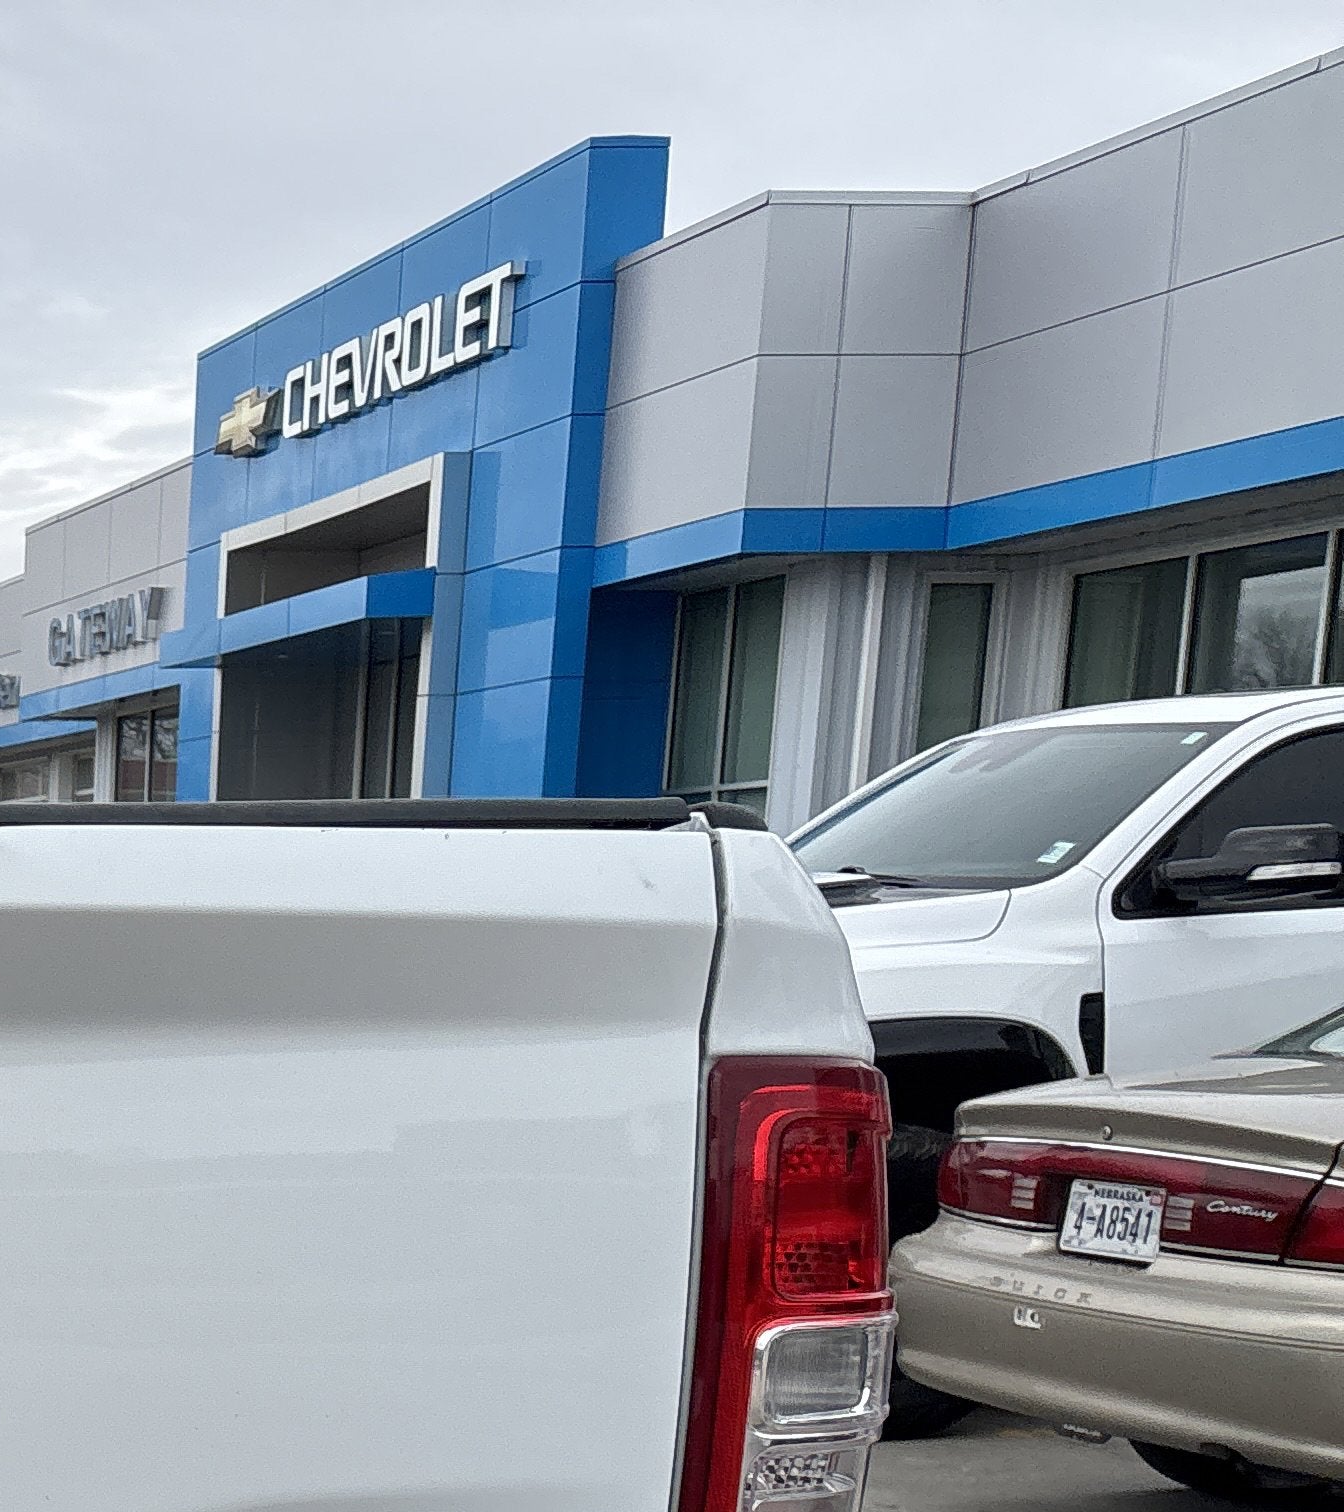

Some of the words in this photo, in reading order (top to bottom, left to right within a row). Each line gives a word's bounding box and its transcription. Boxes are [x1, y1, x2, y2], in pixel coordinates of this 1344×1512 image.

[282, 260, 515, 438] CHEVROLET
[48, 587, 165, 667] GATEWAY
[1094, 1187, 1144, 1202] NEBRASKA
[1206, 1200, 1279, 1222] Century
[1073, 1202, 1154, 1245] 4-A8541
